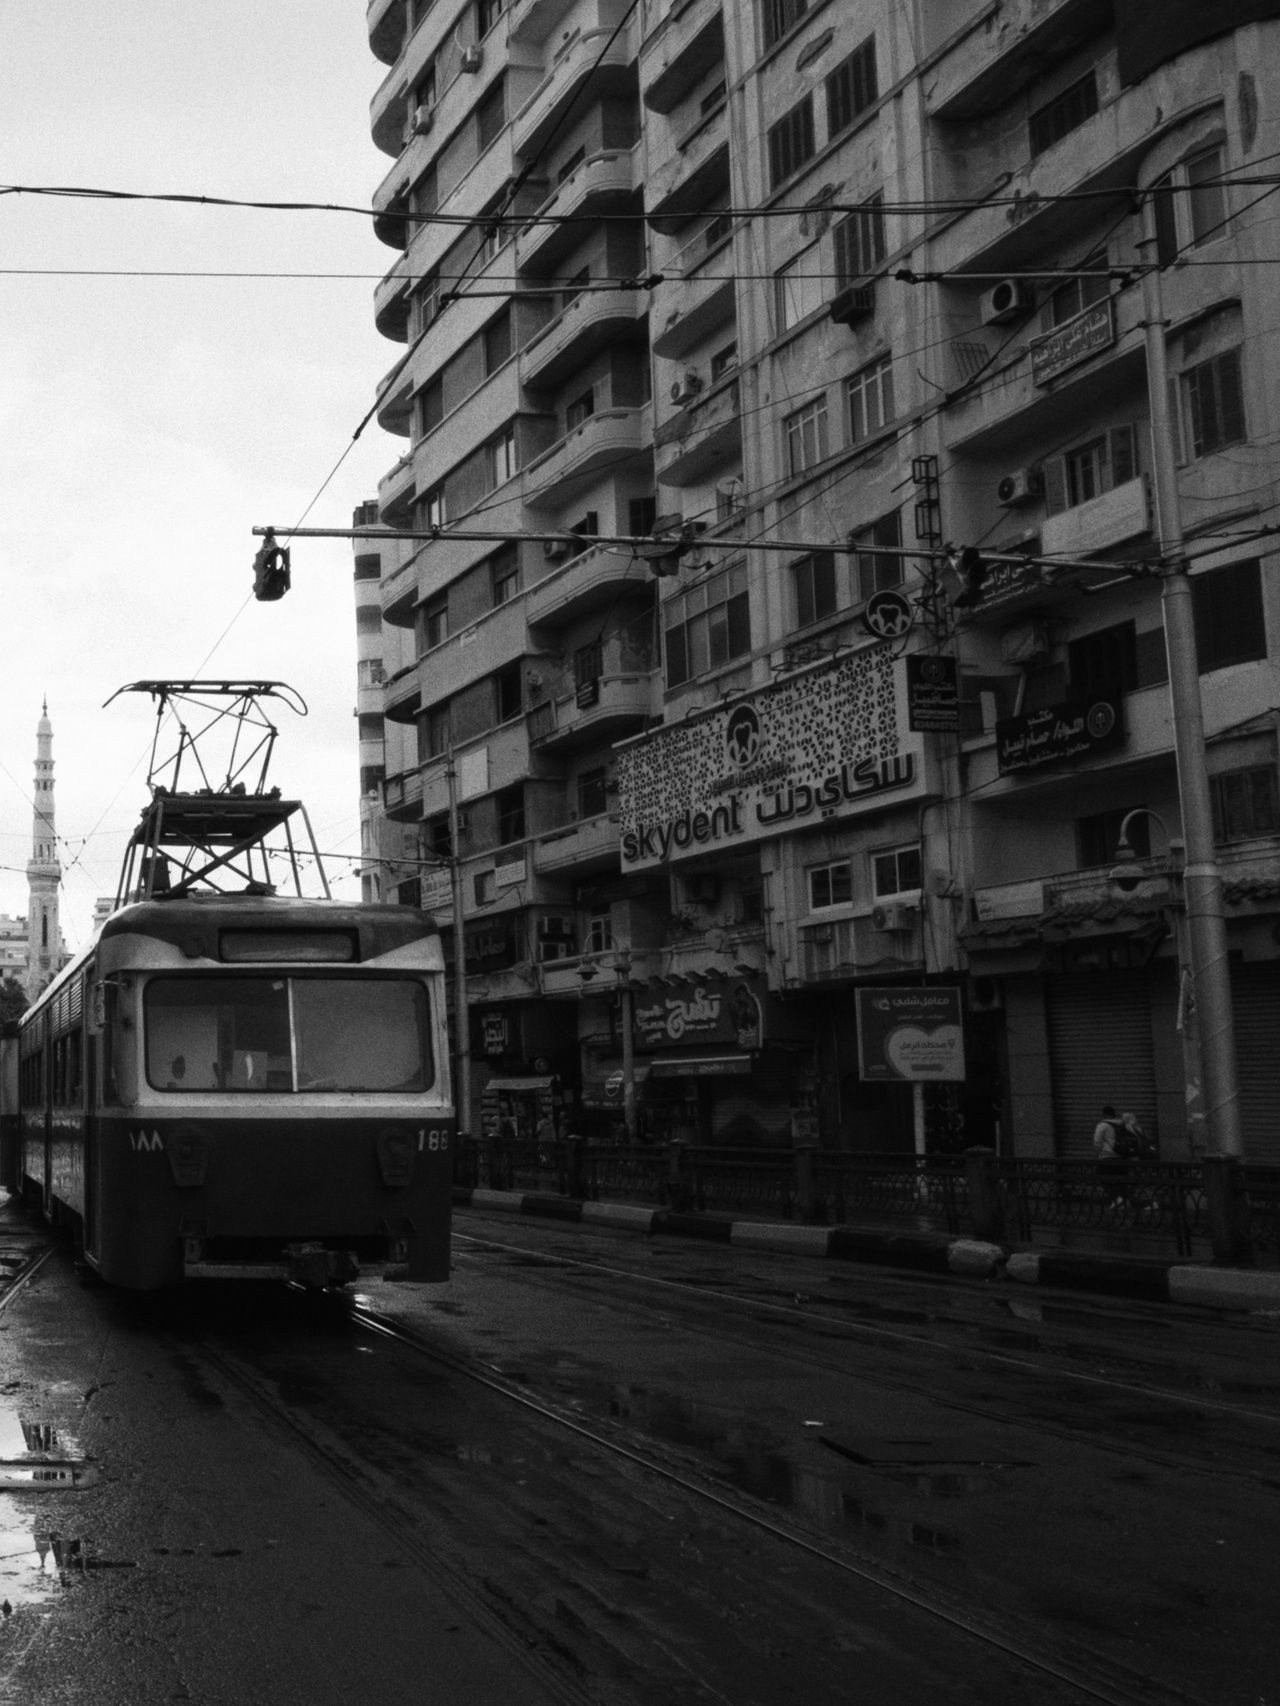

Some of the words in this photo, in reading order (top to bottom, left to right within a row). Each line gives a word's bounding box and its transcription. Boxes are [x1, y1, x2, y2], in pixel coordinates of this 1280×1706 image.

[756, 780, 812, 824] دنت
[815, 752, 912, 818] سكاي
[622, 795, 740, 862] skydent
[129, 1129, 164, 1152] ١٨٨
[418, 1129, 448, 1151] 188
